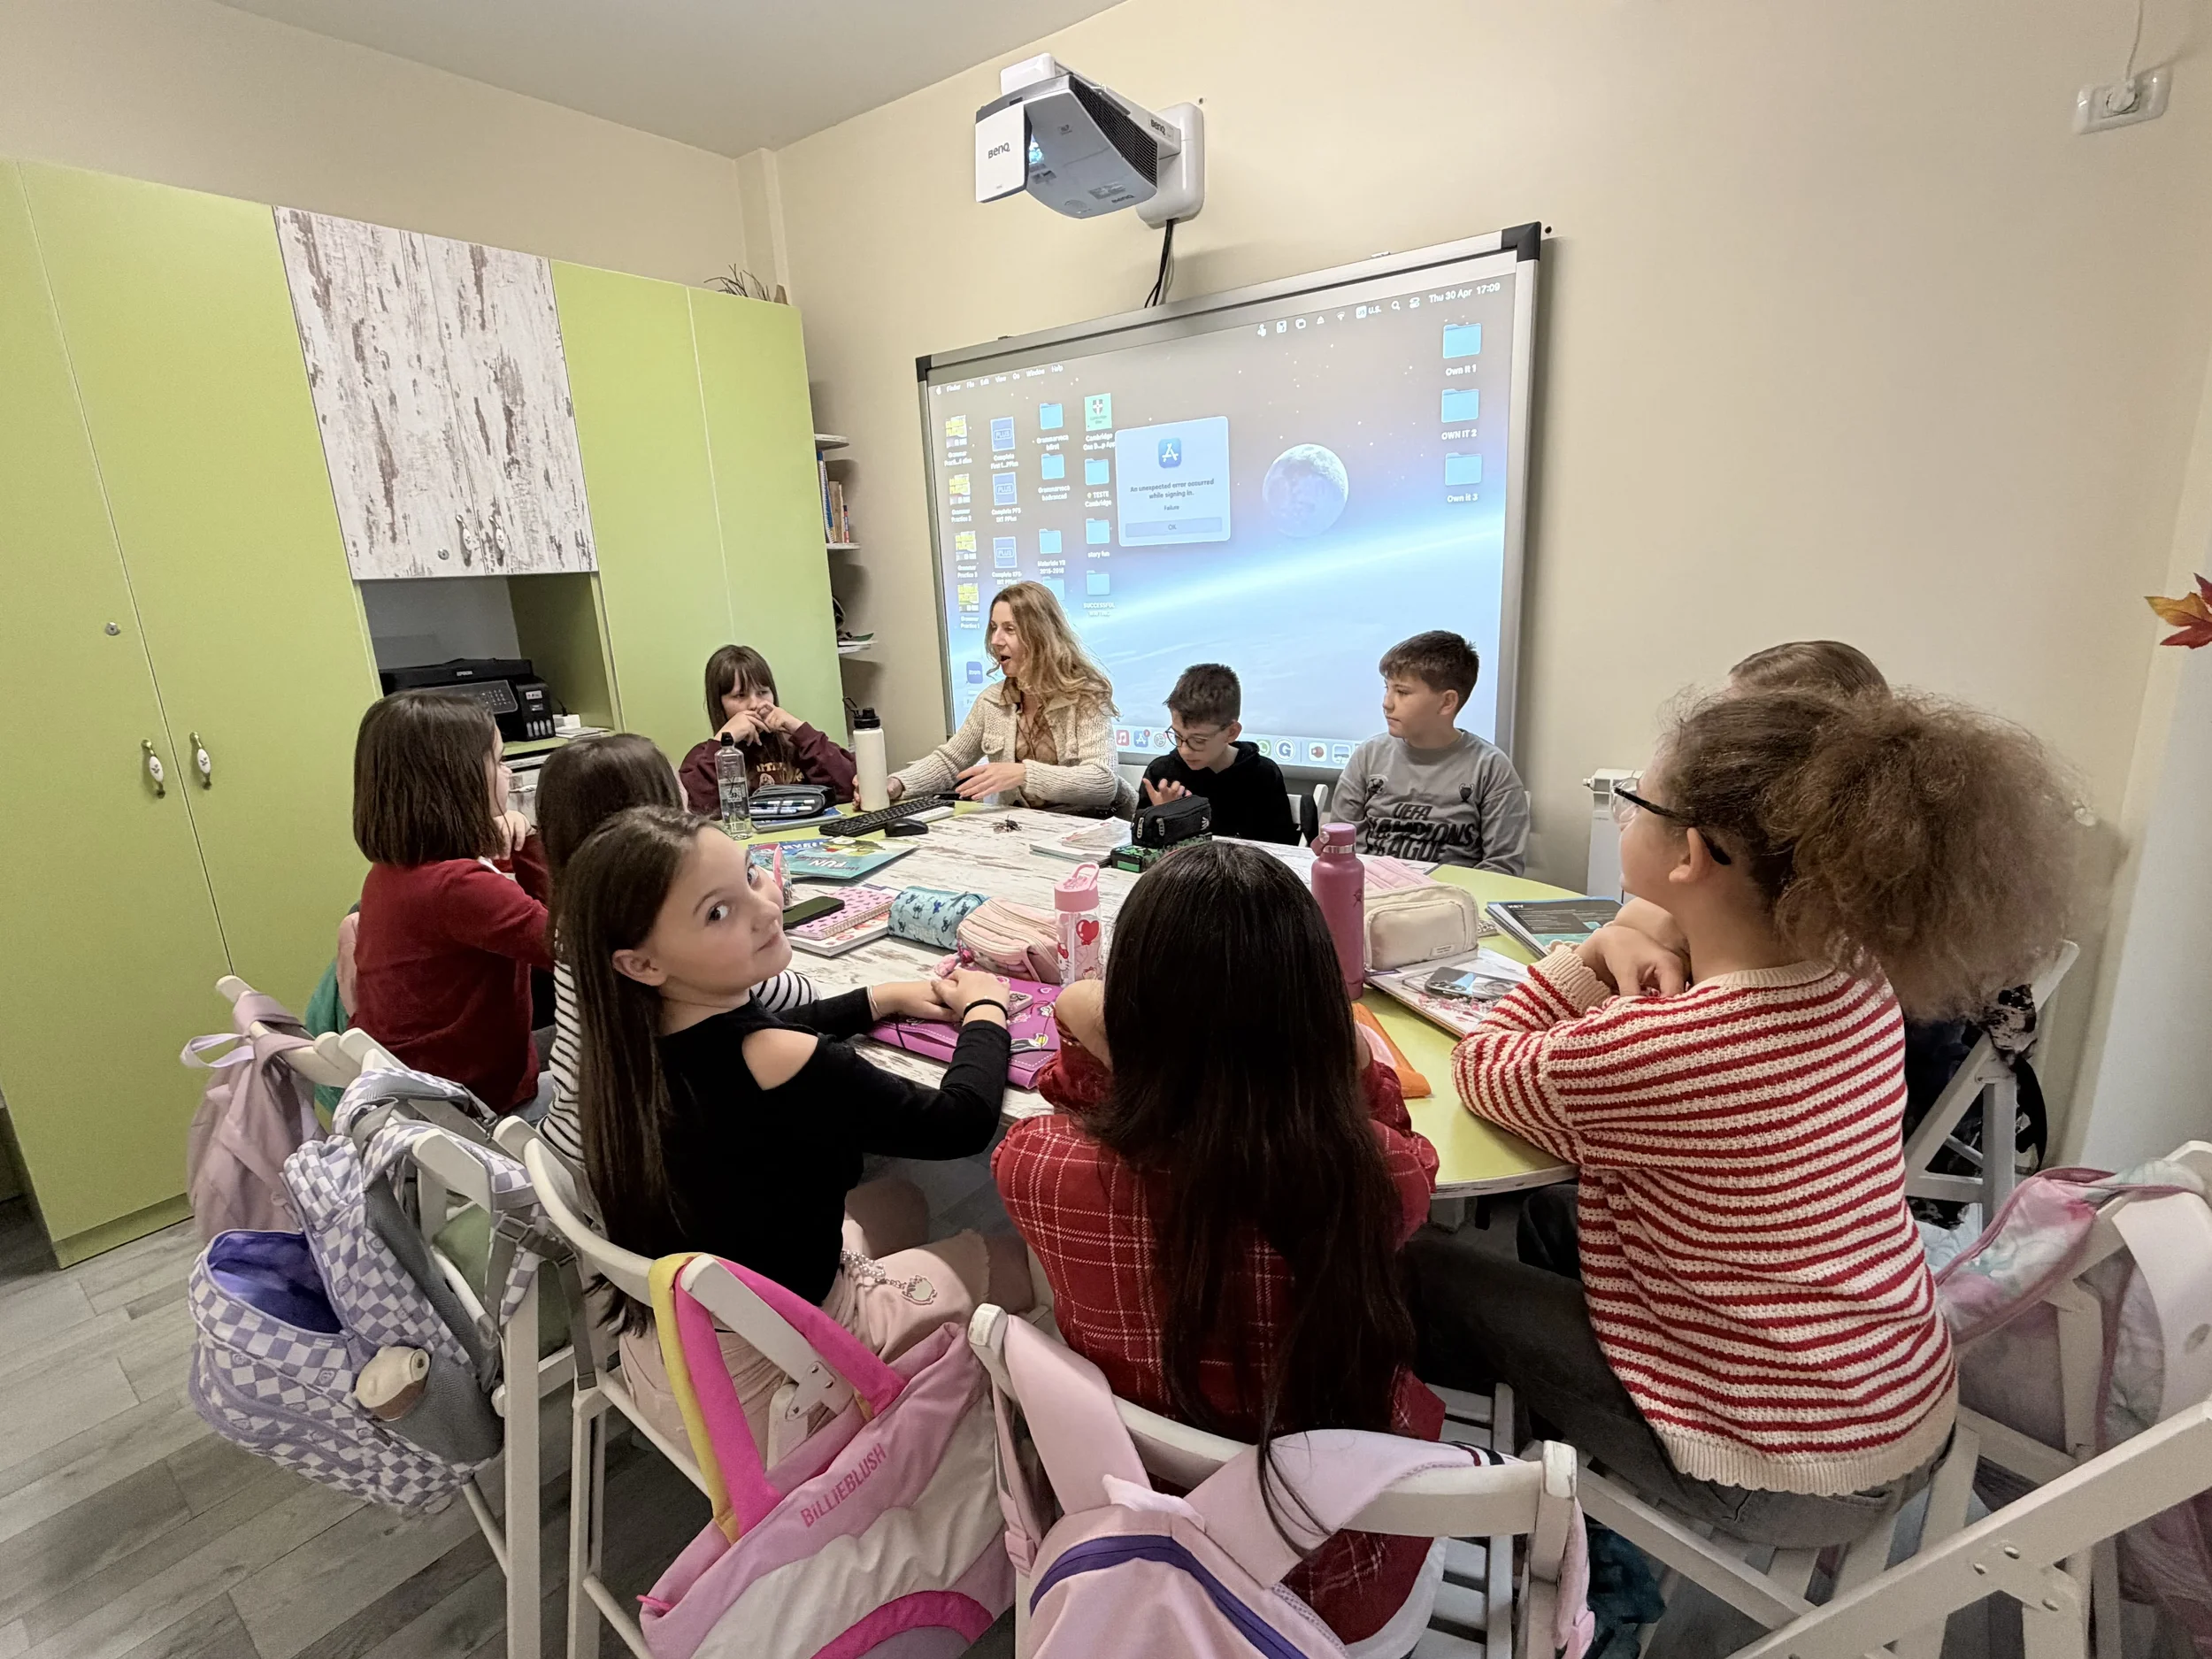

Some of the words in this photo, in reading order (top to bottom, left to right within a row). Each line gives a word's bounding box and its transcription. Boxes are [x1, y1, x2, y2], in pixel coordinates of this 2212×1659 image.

[1149, 119, 1166, 135] BenQ
[987, 142, 1010, 159] BenQ
[1428, 294, 1444, 303] Thu
[1445, 290, 1456, 301] 30
[1457, 288, 1473, 299] Apr
[1445, 367, 1464, 376] Own
[1085, 433, 1113, 442] Cambridge
[1441, 430, 1461, 440] OWN
[1471, 428, 1478, 437] 2
[1139, 482, 1171, 492] unexpected
[1187, 478, 1215, 487] occurred
[1393, 803, 1433, 820] UEFA
[1368, 817, 1478, 846] AMPIONS
[808, 859, 848, 868] FUN
